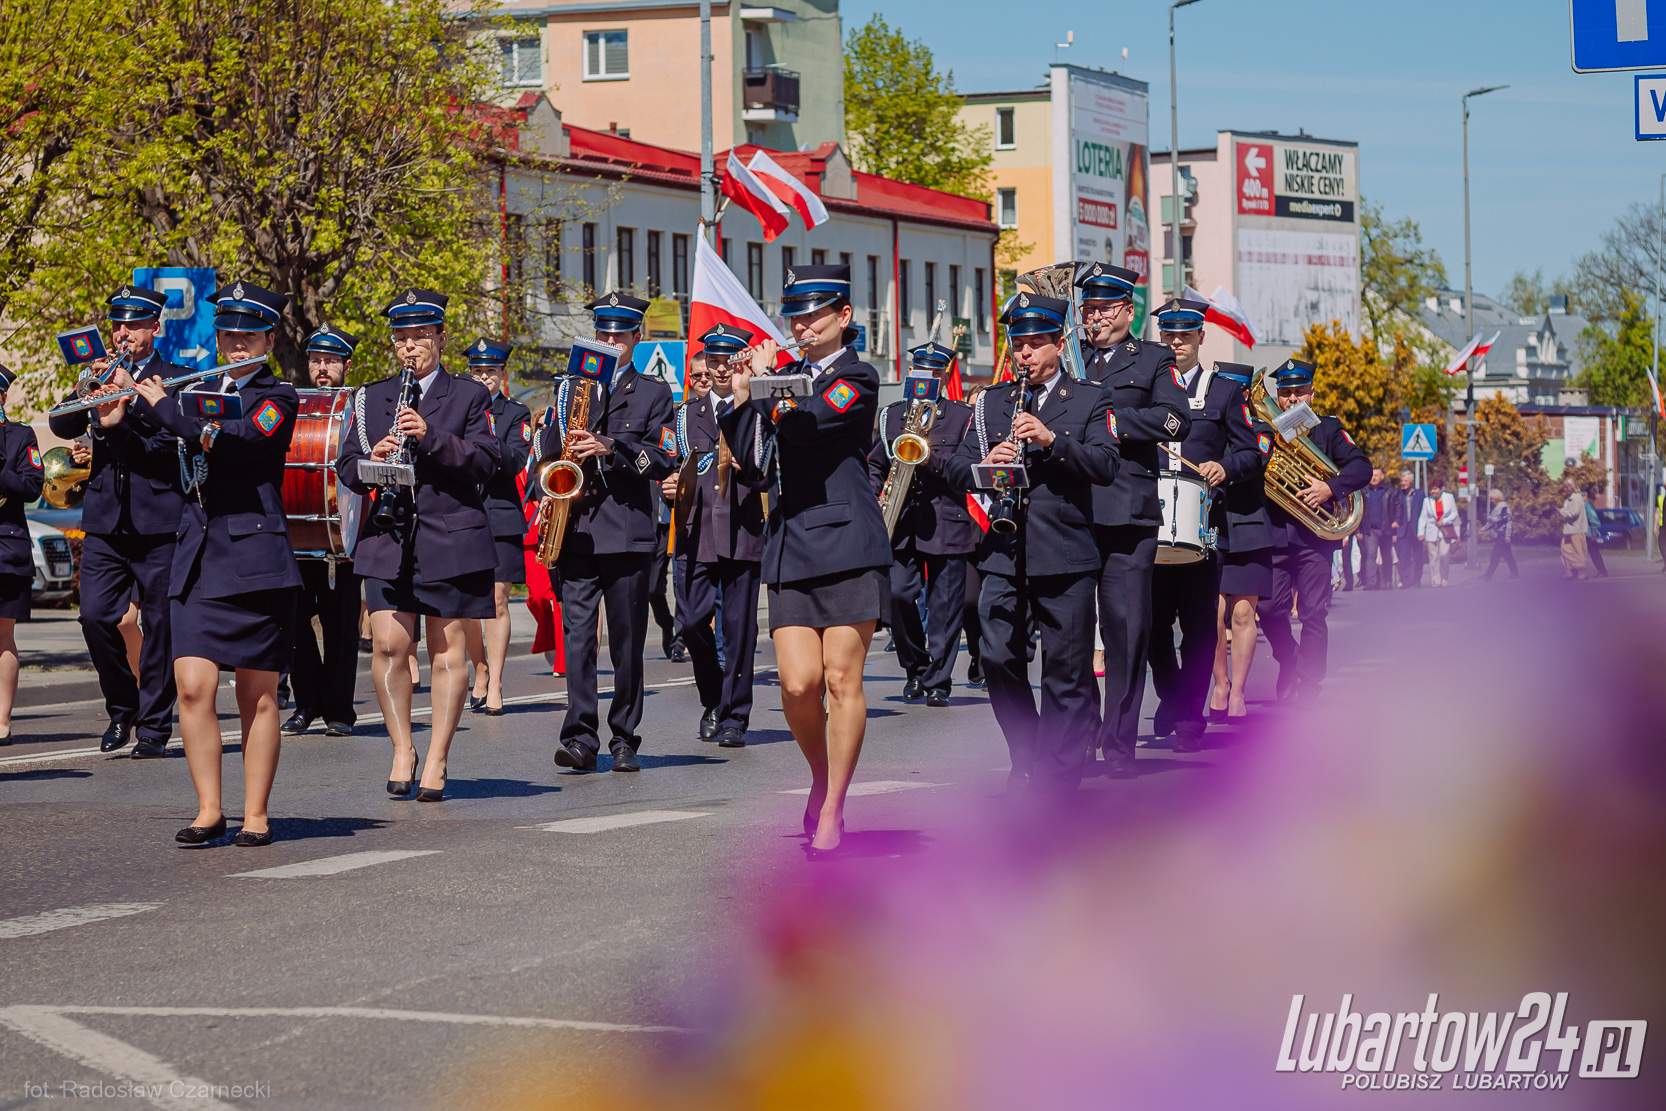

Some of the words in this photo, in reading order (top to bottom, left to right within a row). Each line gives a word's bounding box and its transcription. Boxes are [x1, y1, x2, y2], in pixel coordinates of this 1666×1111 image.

[1076, 139, 1123, 180] LOTERIA
[1285, 173, 1315, 194] NISKIE
[1318, 176, 1344, 197] CENY!
[154, 278, 195, 337] P
